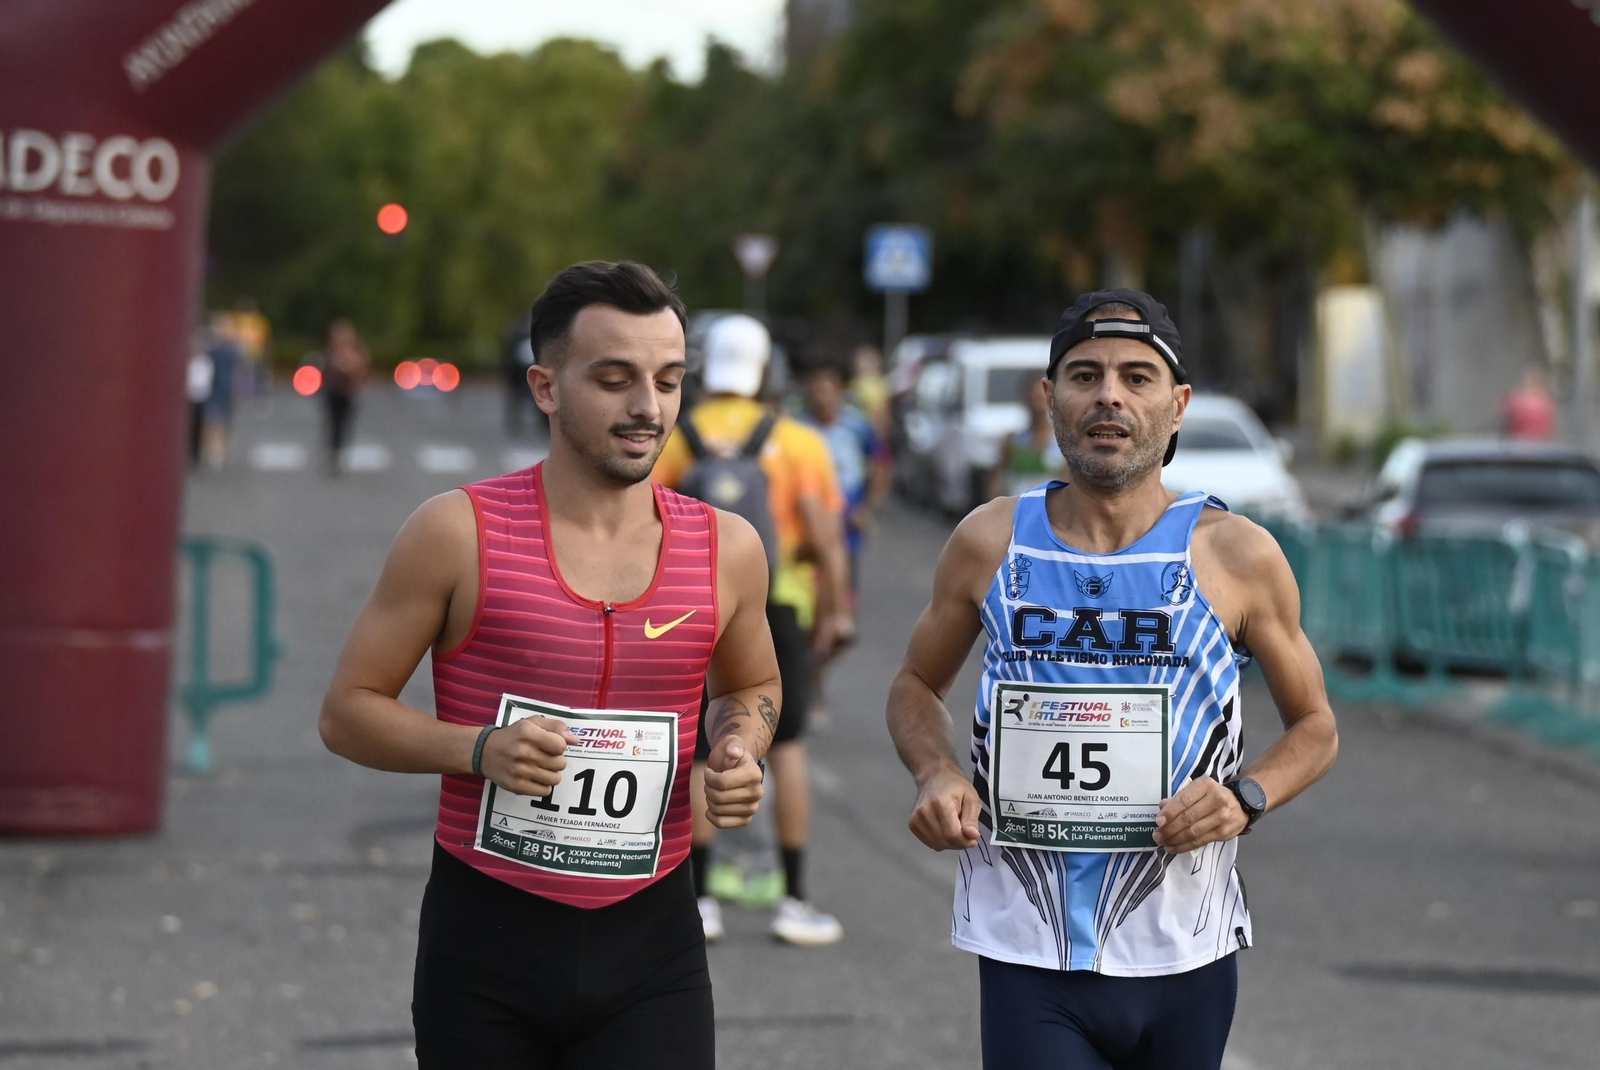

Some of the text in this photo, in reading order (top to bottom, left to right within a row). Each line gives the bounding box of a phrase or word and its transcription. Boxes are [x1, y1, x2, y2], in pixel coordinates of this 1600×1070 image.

[0, 128, 180, 202] DECO
[1011, 605, 1177, 654] CAR
[1030, 650, 1108, 664] ATLETISMO
[1111, 655, 1190, 667] RINCONADA
[1040, 701, 1112, 712] FESTIVAL
[1034, 711, 1112, 722] ATLETISMO
[567, 726, 628, 740] ESTIVAL
[1042, 742, 1111, 791] 45
[536, 814, 621, 829] JAVIER TEJADA FERNÁNDEZ
[1031, 824, 1045, 834] 28
[1048, 824, 1069, 840] 5k
[523, 841, 540, 853] 28
[542, 844, 566, 863] 5k
[569, 850, 592, 858] XXXIX
[567, 857, 622, 868] [La Fuensanta]
